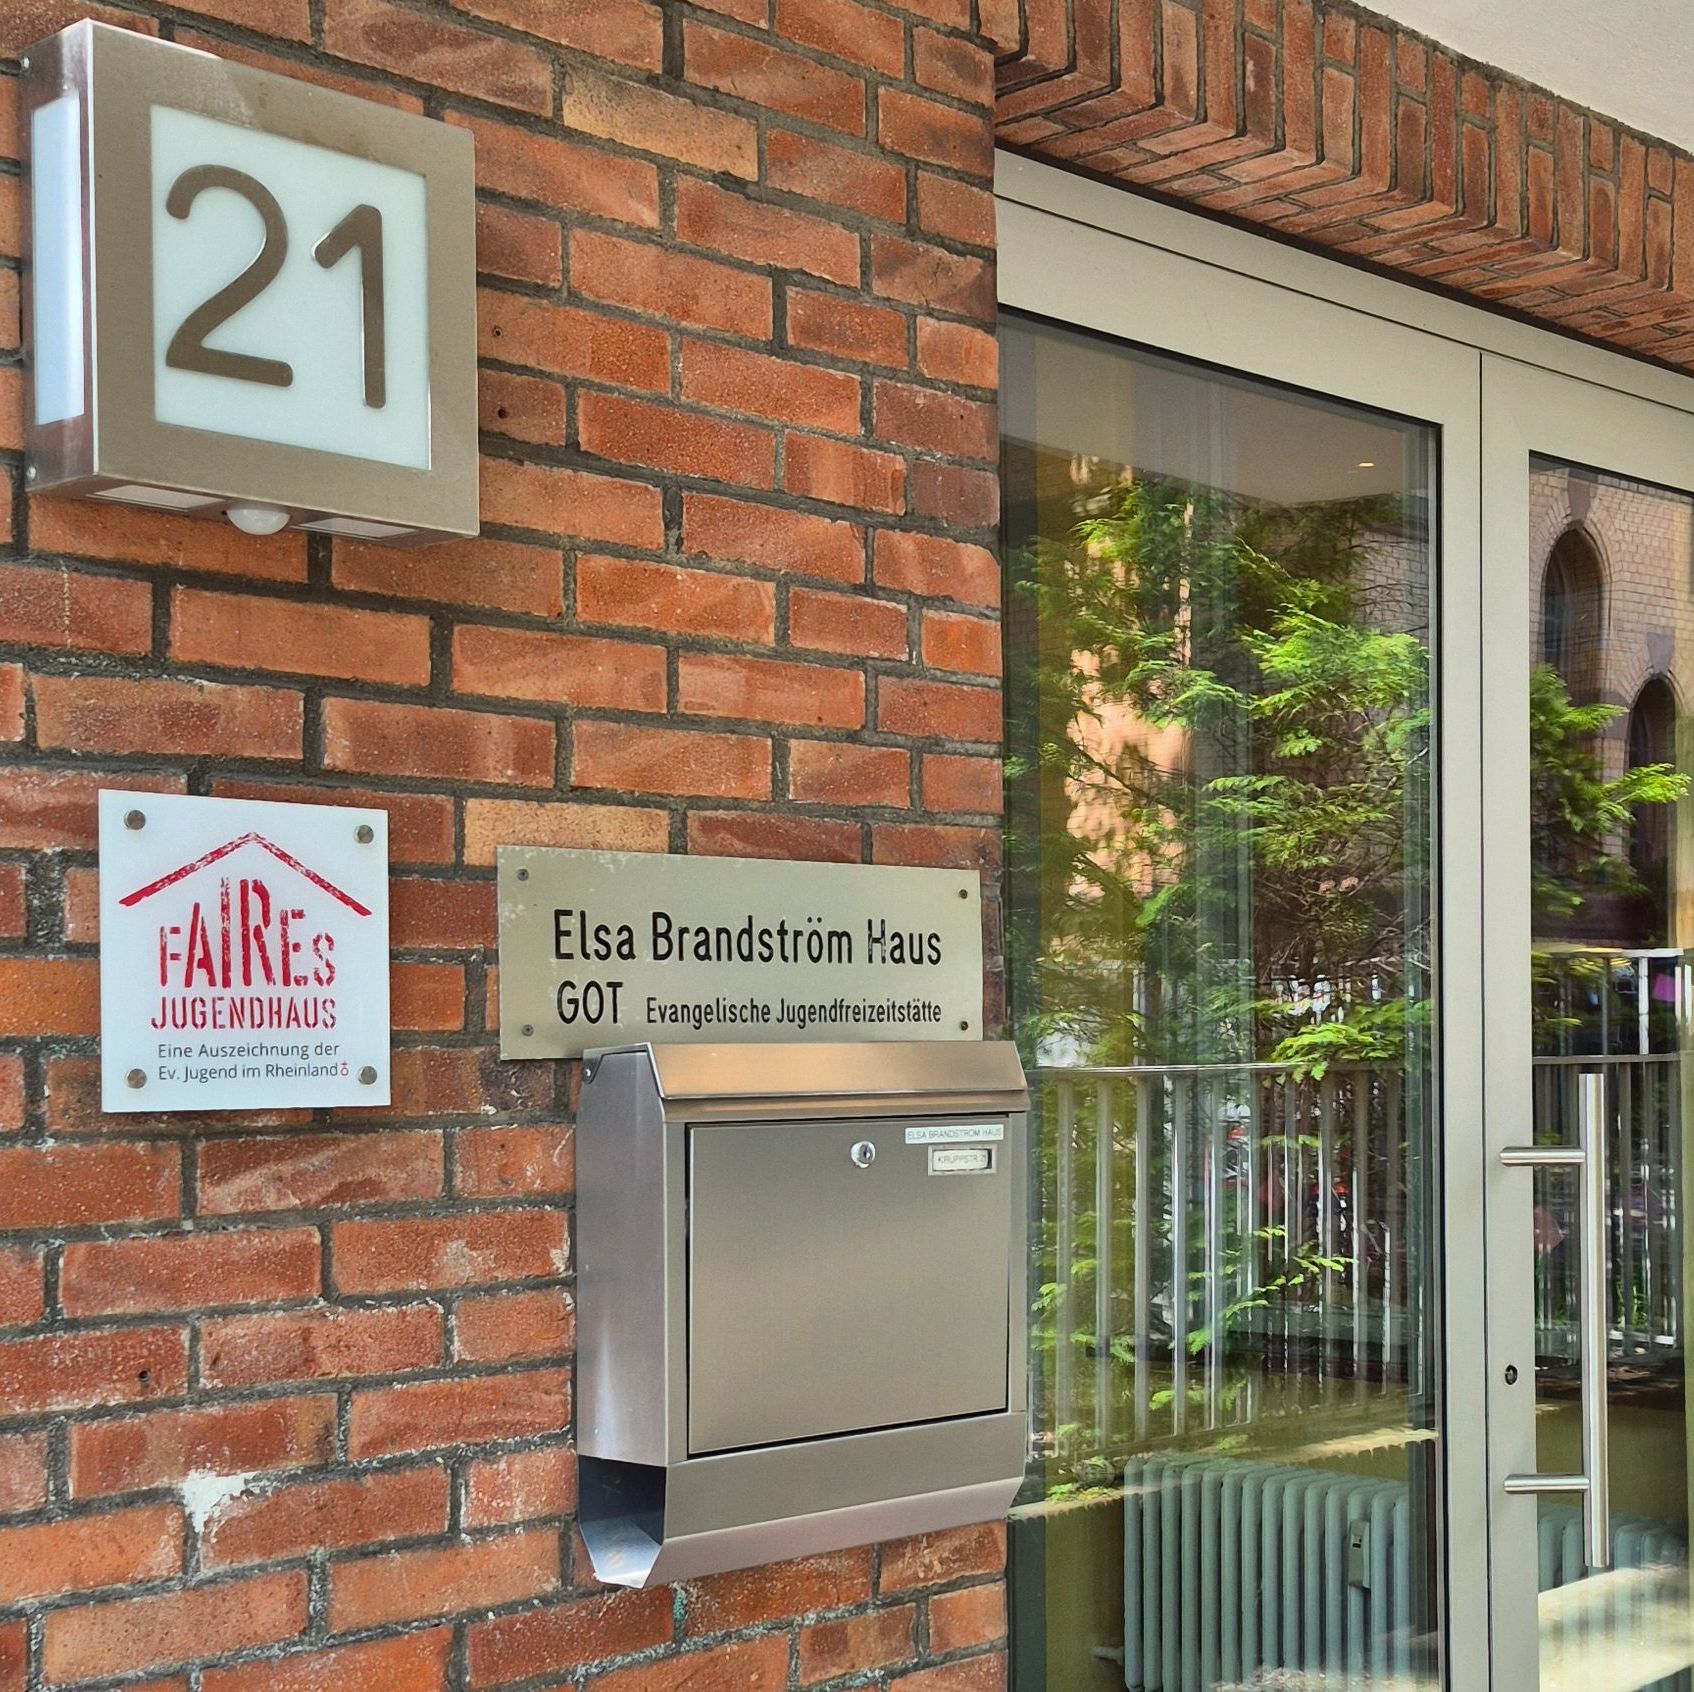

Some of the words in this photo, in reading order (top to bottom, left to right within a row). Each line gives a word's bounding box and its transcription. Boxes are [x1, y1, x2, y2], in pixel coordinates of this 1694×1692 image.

[165, 163, 387, 409] 21
[553, 908, 636, 961] Elsa
[651, 911, 853, 965] Brandström
[866, 918, 943, 966] Haus
[150, 995, 337, 1030] JUGENDHAUS
[556, 979, 624, 1026] GOT
[646, 996, 771, 1030] Evangelische
[776, 997, 942, 1030] Jugendfreizeitstätte
[157, 1043, 193, 1059] Eine
[198, 1042, 309, 1060] Auszeichnung
[314, 1042, 340, 1057] der
[158, 1065, 181, 1080] Ev.
[183, 1064, 238, 1083] Jugend
[242, 1063, 261, 1079] im
[265, 1062, 338, 1078] Rheinland
[907, 1130, 926, 1139] ELSA
[982, 1127, 1001, 1137] HAUS
